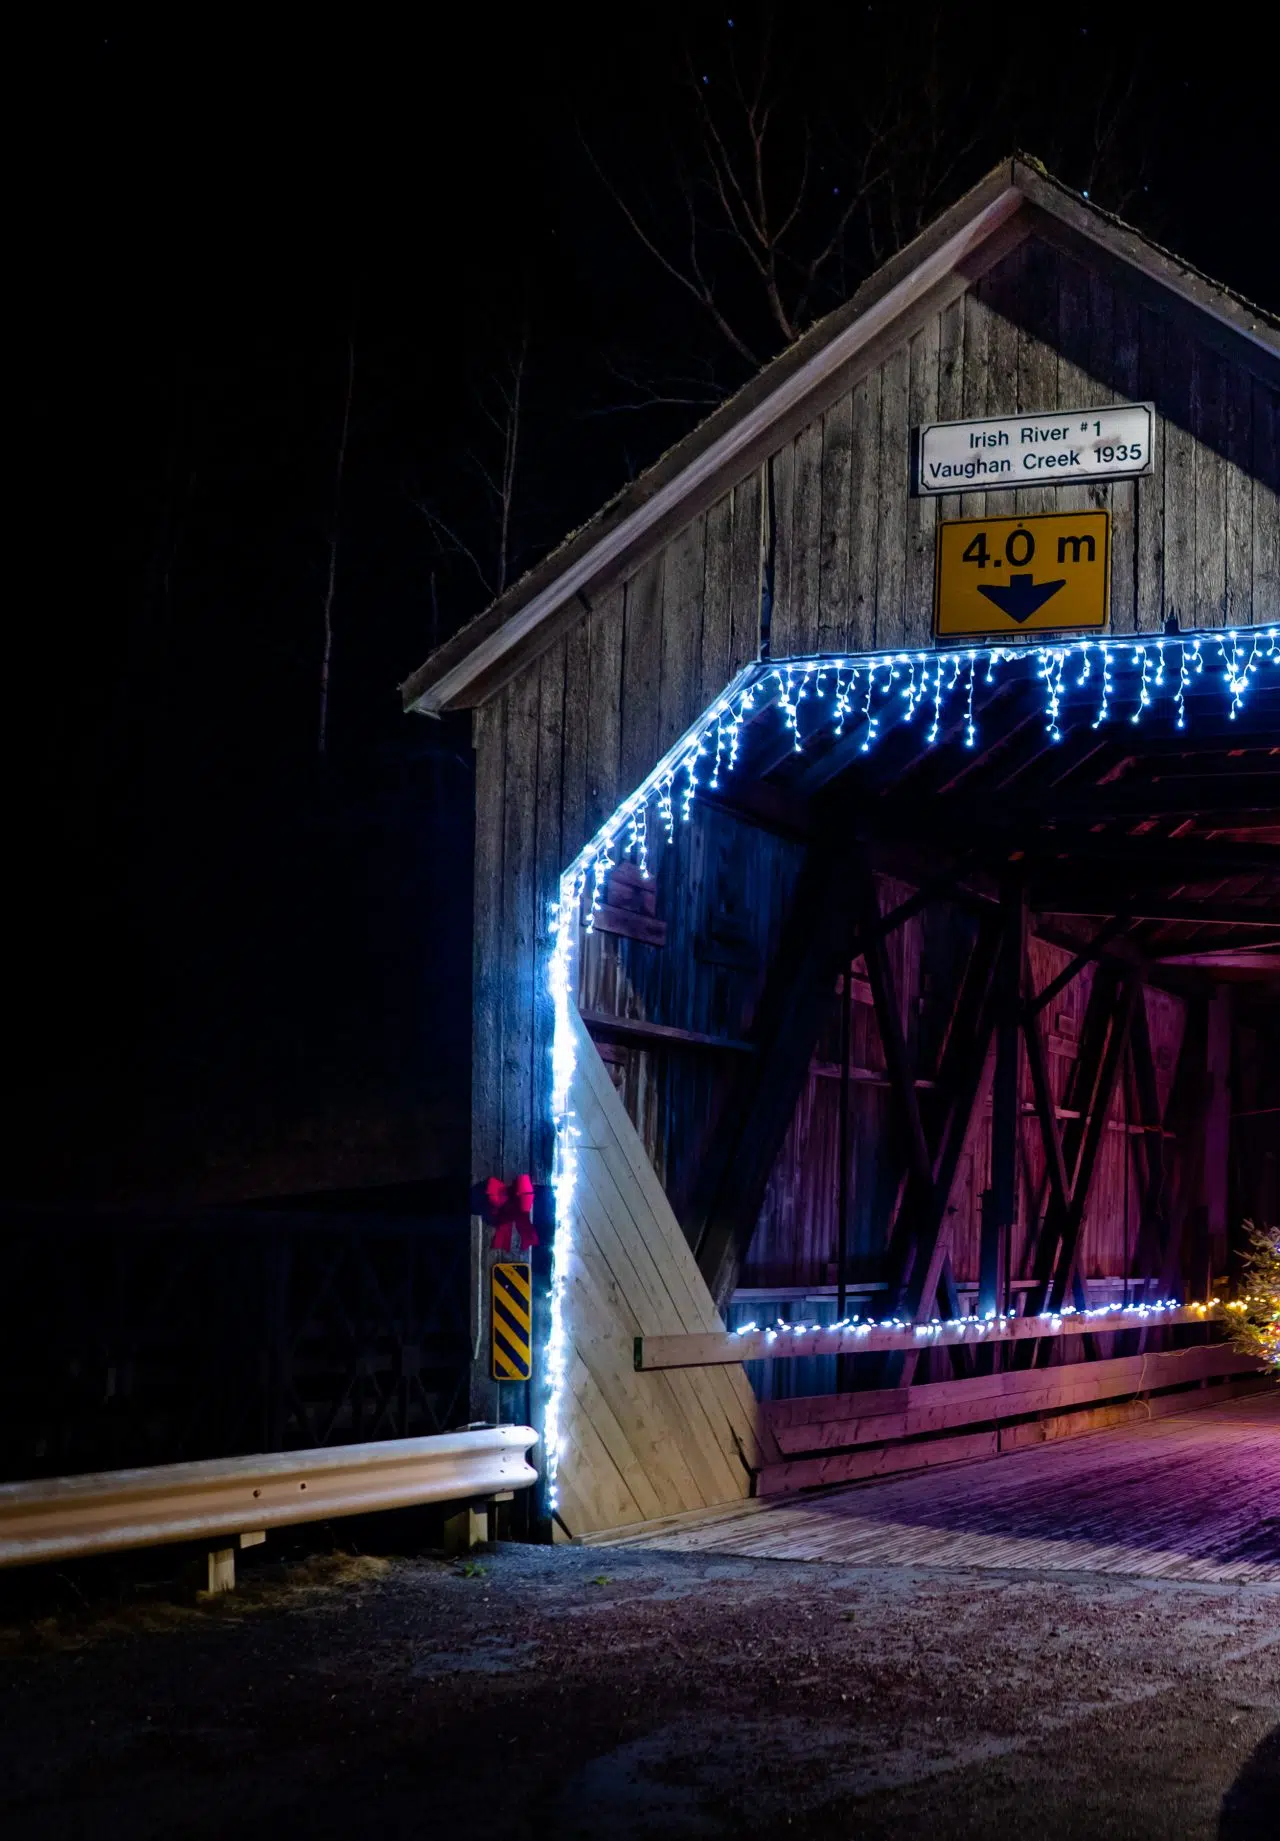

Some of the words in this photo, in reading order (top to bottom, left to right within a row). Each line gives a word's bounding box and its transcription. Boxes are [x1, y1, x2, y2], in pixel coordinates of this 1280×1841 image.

[969, 430, 1009, 449] Irish
[1020, 427, 1070, 444] River
[929, 458, 1011, 479] Vaughan
[1023, 450, 1081, 470] Creek
[1093, 443, 1142, 464] 1935
[962, 529, 1035, 568] 4.0
[1057, 533, 1095, 563] m
